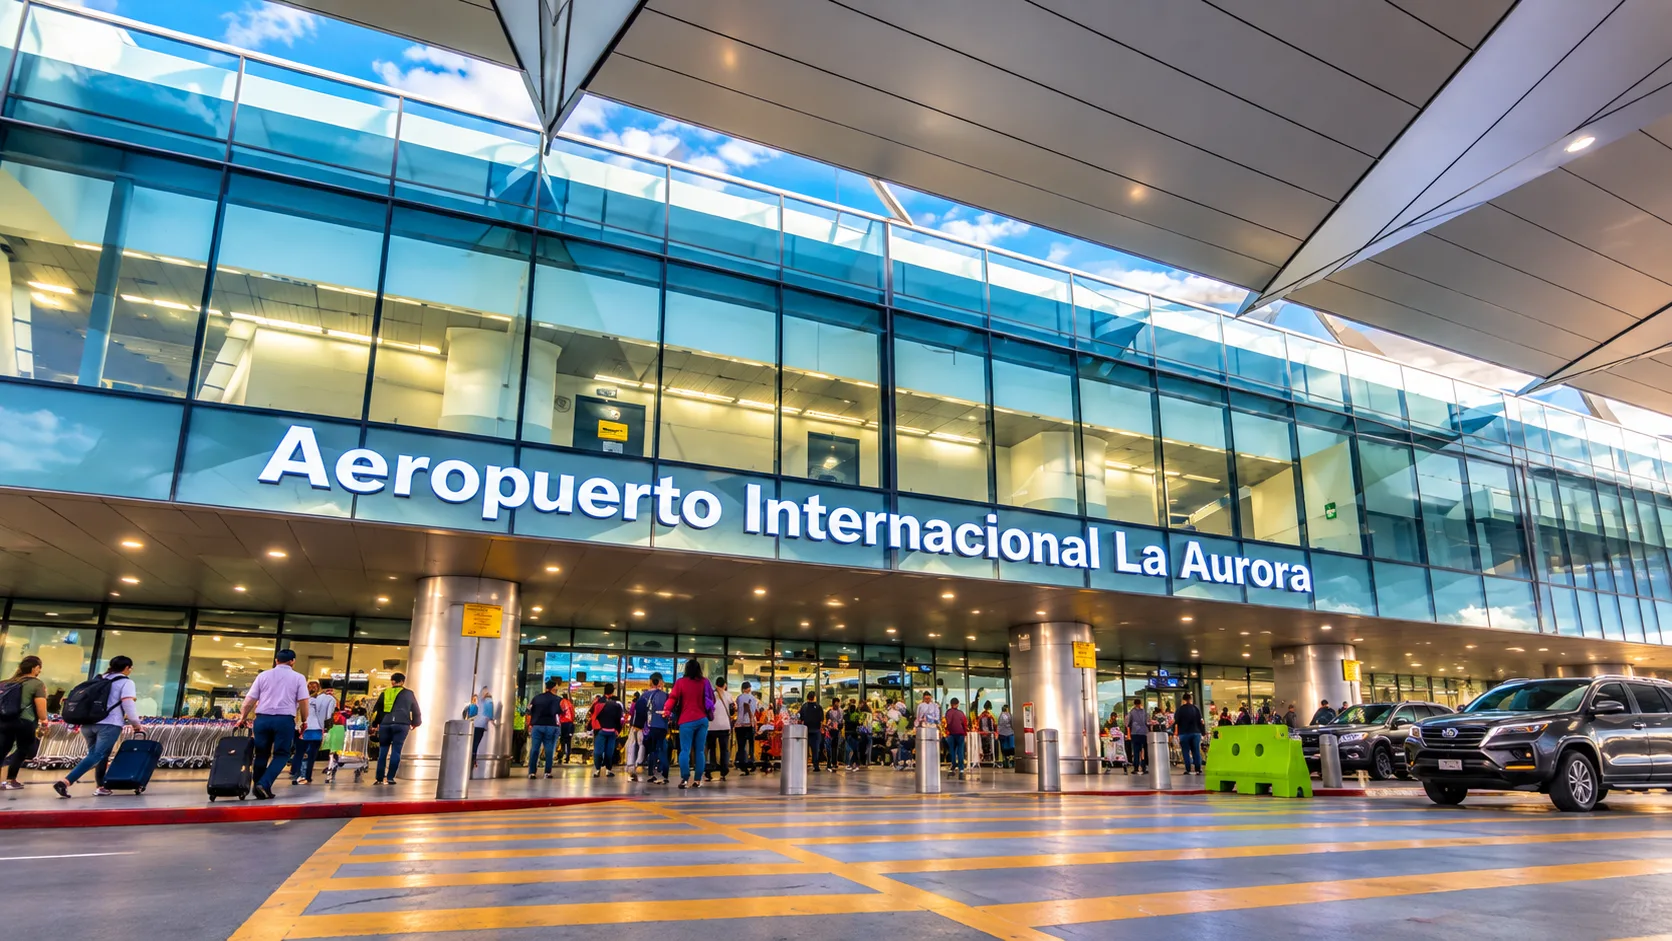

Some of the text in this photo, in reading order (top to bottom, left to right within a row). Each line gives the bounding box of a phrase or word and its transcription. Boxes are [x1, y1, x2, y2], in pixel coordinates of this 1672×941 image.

[258, 425, 1311, 592] Aeropuerto Internacional La Aurora
